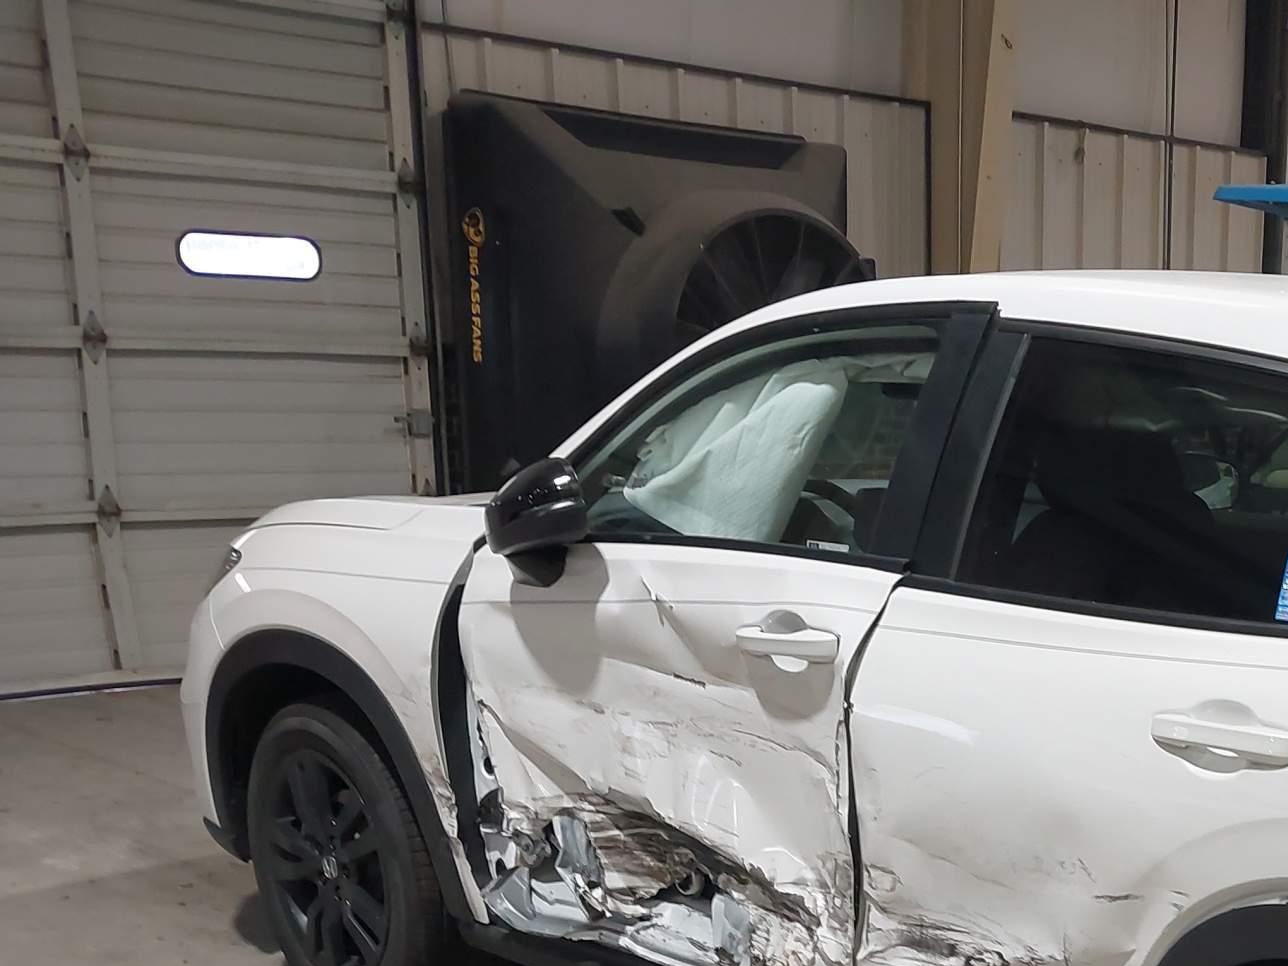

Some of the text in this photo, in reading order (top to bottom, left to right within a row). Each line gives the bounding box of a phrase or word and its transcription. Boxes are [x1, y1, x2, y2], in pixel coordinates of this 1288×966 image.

[468, 246, 482, 362] BIG ASS FANS
